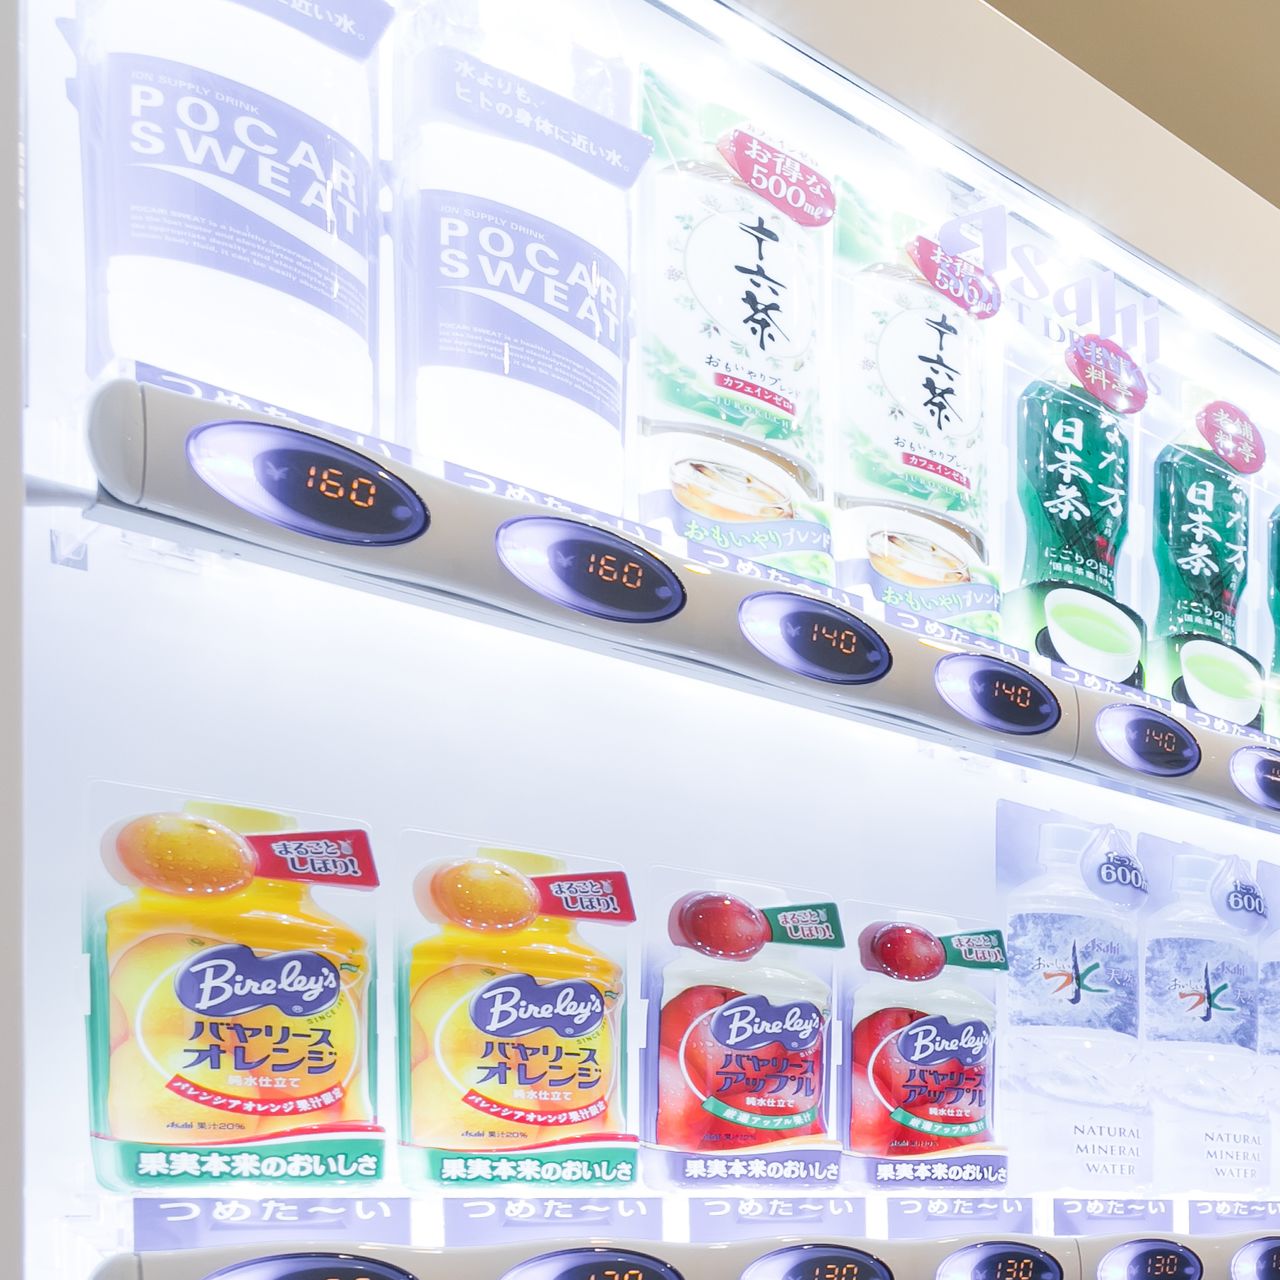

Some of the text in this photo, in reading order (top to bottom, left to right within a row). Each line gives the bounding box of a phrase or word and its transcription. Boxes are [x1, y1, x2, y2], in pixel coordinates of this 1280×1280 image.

[158, 75, 211, 97] SUPPLY
[215, 91, 259, 115] DRINK
[130, 121, 360, 235] SWEAT
[744, 139, 827, 198] お得な
[463, 207, 546, 242] SUPPLY DRINK
[440, 249, 620, 342] SWEAT
[734, 216, 790, 351] 十六茶
[917, 313, 963, 430] 十六茶
[1044, 418, 1093, 520] 日本茶
[1097, 411, 1126, 517] なだ万
[307, 465, 376, 508] 160
[1177, 481, 1222, 576] 日本茶
[588, 554, 643, 588] 160
[812, 623, 857, 655] 140
[994, 680, 1031, 708] 140
[1145, 726, 1176, 753] 140
[272, 841, 340, 857] まるごと
[289, 856, 358, 876] しぼり!
[552, 883, 602, 896] まるごと
[779, 911, 820, 925] まるごと
[953, 936, 992, 949] まるごと
[1084, 937, 1120, 957] Asahi
[189, 958, 336, 1010] Bireley's
[483, 987, 602, 1031] Bireley's
[188, 1022, 333, 1048] バヤリース
[724, 1005, 821, 1046] Bireley's
[480, 1041, 599, 1066] バヤリース
[908, 1026, 994, 1060] Bireley's
[182, 1048, 338, 1073] オレンジ
[720, 1054, 815, 1073] バヤリース
[476, 1063, 602, 1089] オレンジ
[716, 1070, 815, 1098] アップル
[908, 1069, 987, 1087] バヤリース
[902, 1084, 986, 1107] アップル
[1073, 1124, 1142, 1140] NATURAL
[1204, 1132, 1263, 1146] NATURAL
[1076, 1143, 1142, 1158] MINERAL
[1206, 1150, 1262, 1163] MINERAL
[138, 1152, 377, 1176] 果実本来のおいしさ
[441, 1159, 632, 1181] 果実本来のおいしさ
[685, 1159, 839, 1179] 果実本来のおいしさ
[1086, 1162, 1136, 1177] WATER
[1215, 1167, 1257, 1180] WATER
